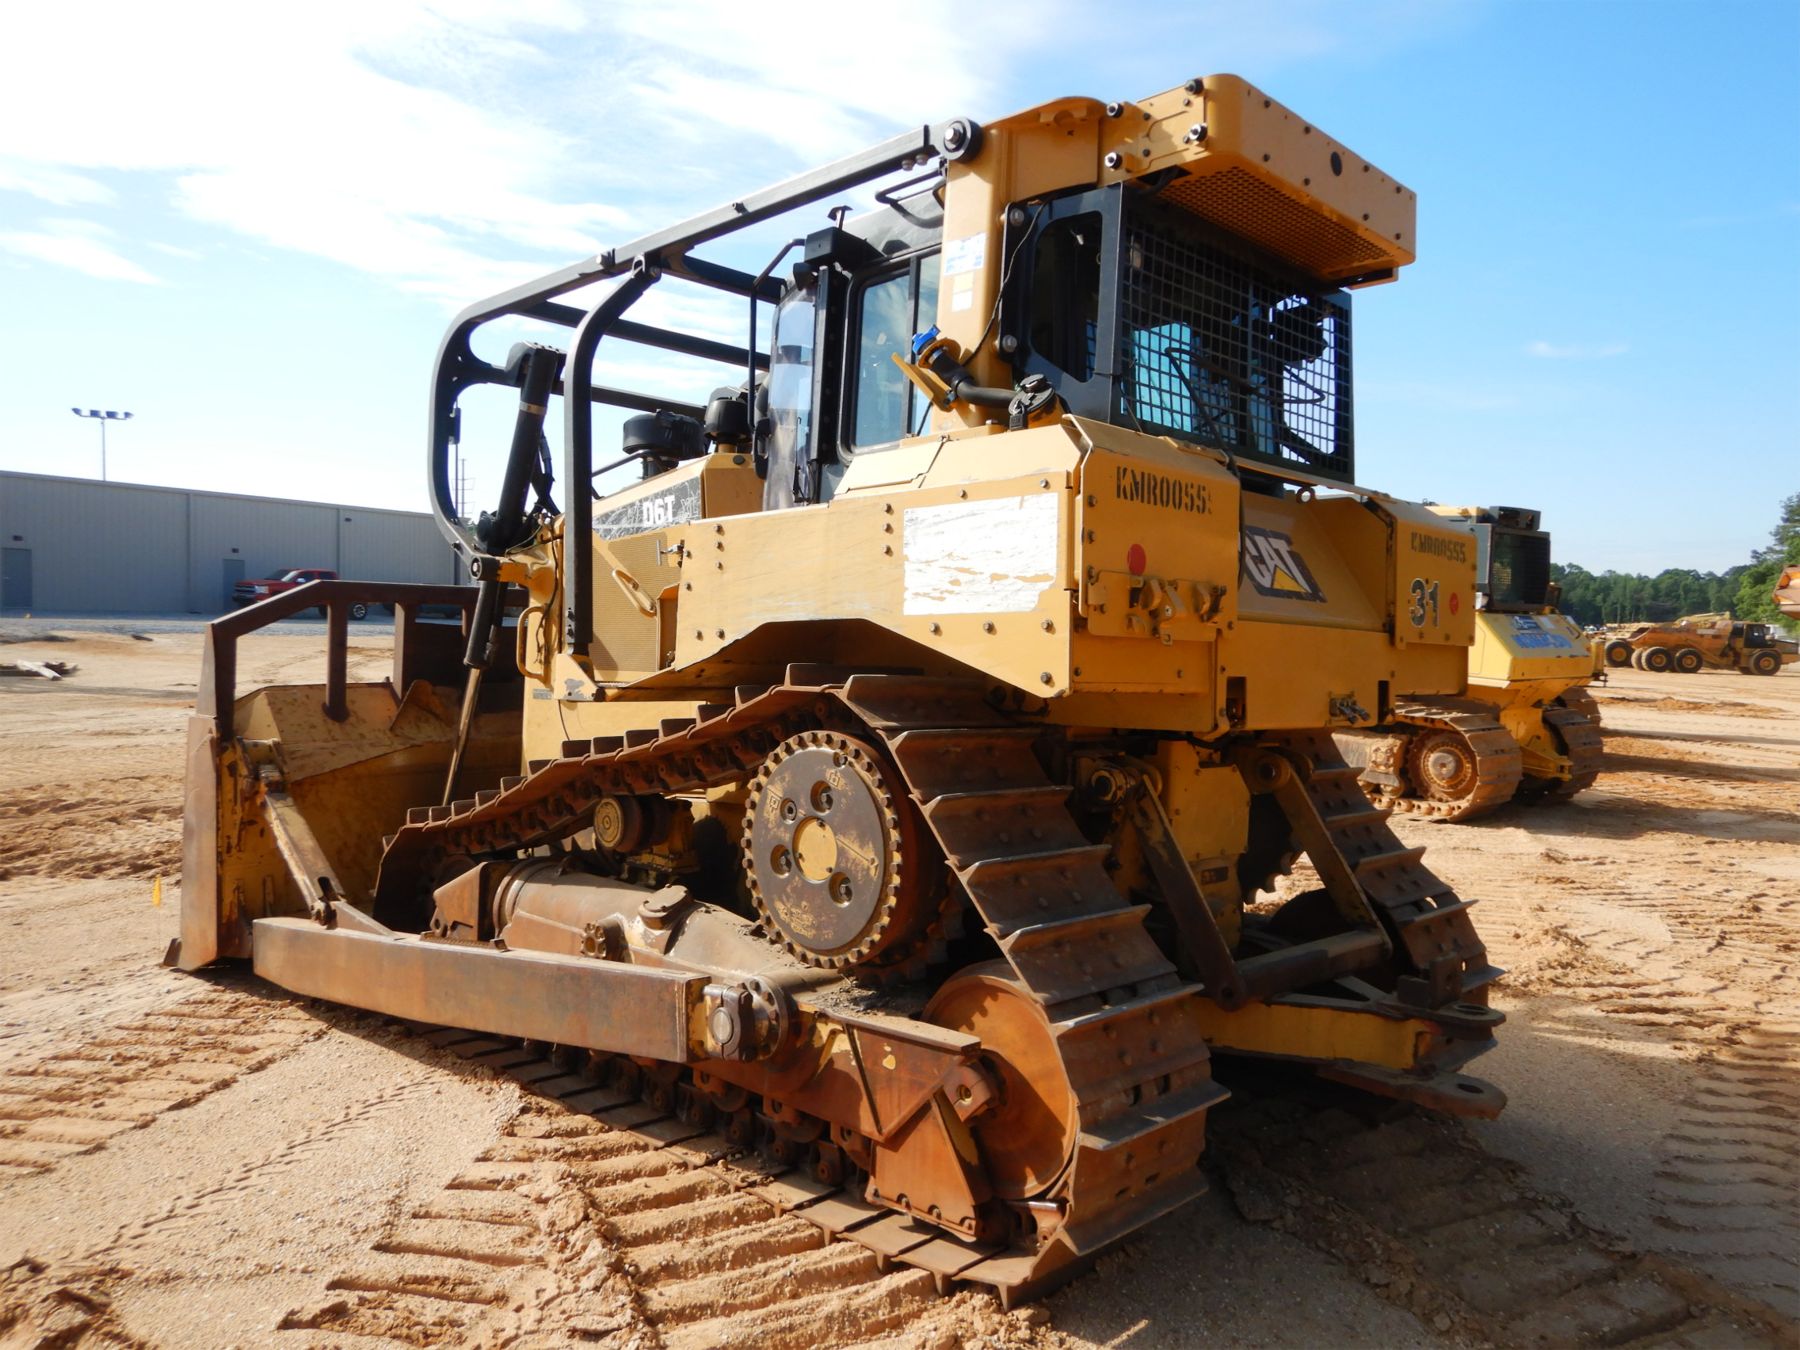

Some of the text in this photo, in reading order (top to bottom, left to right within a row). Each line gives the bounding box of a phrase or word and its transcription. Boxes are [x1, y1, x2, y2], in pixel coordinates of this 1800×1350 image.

[642, 495, 675, 527] D6T
[1245, 533, 1313, 594] CAT
[1409, 577, 1440, 628] 31
